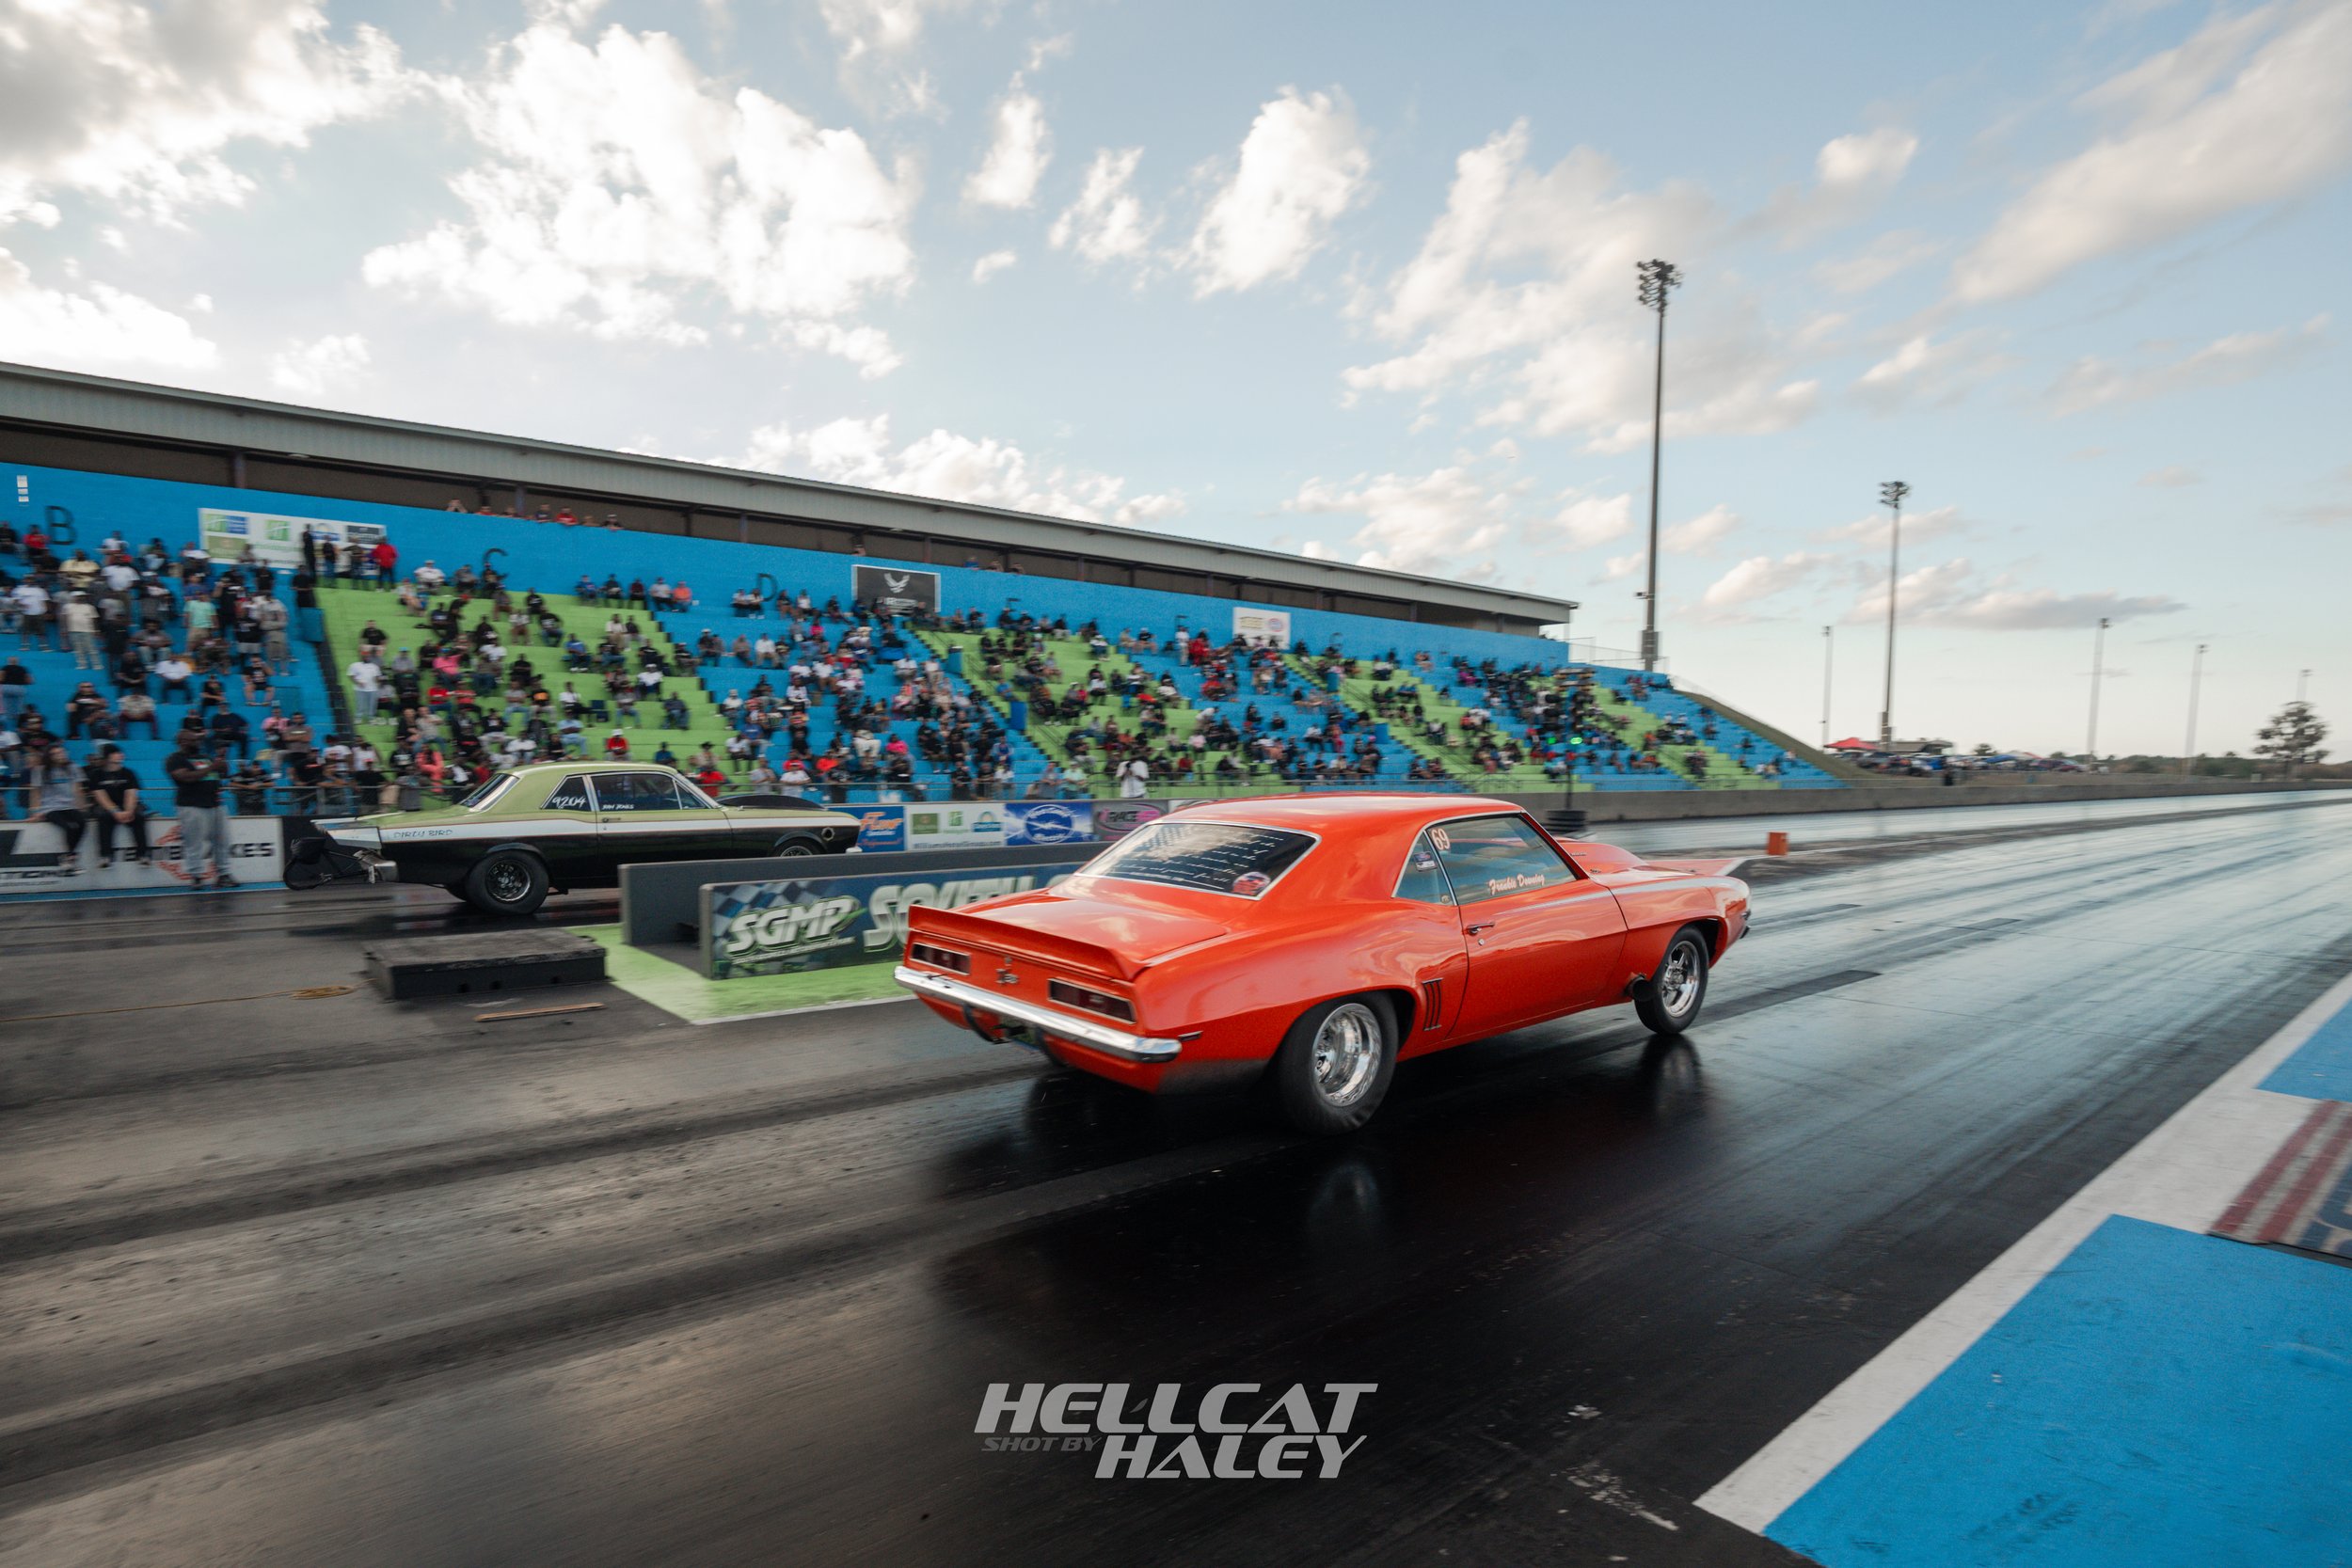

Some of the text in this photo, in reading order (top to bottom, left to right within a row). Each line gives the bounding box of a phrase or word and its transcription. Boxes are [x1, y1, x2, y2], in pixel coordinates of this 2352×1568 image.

[44, 505, 77, 546] B
[756, 573, 778, 602] D
[552, 796, 587, 810] 9204
[428, 828, 453, 837] BIRD
[1431, 828, 1451, 850] 69
[726, 897, 856, 954] SGMP
